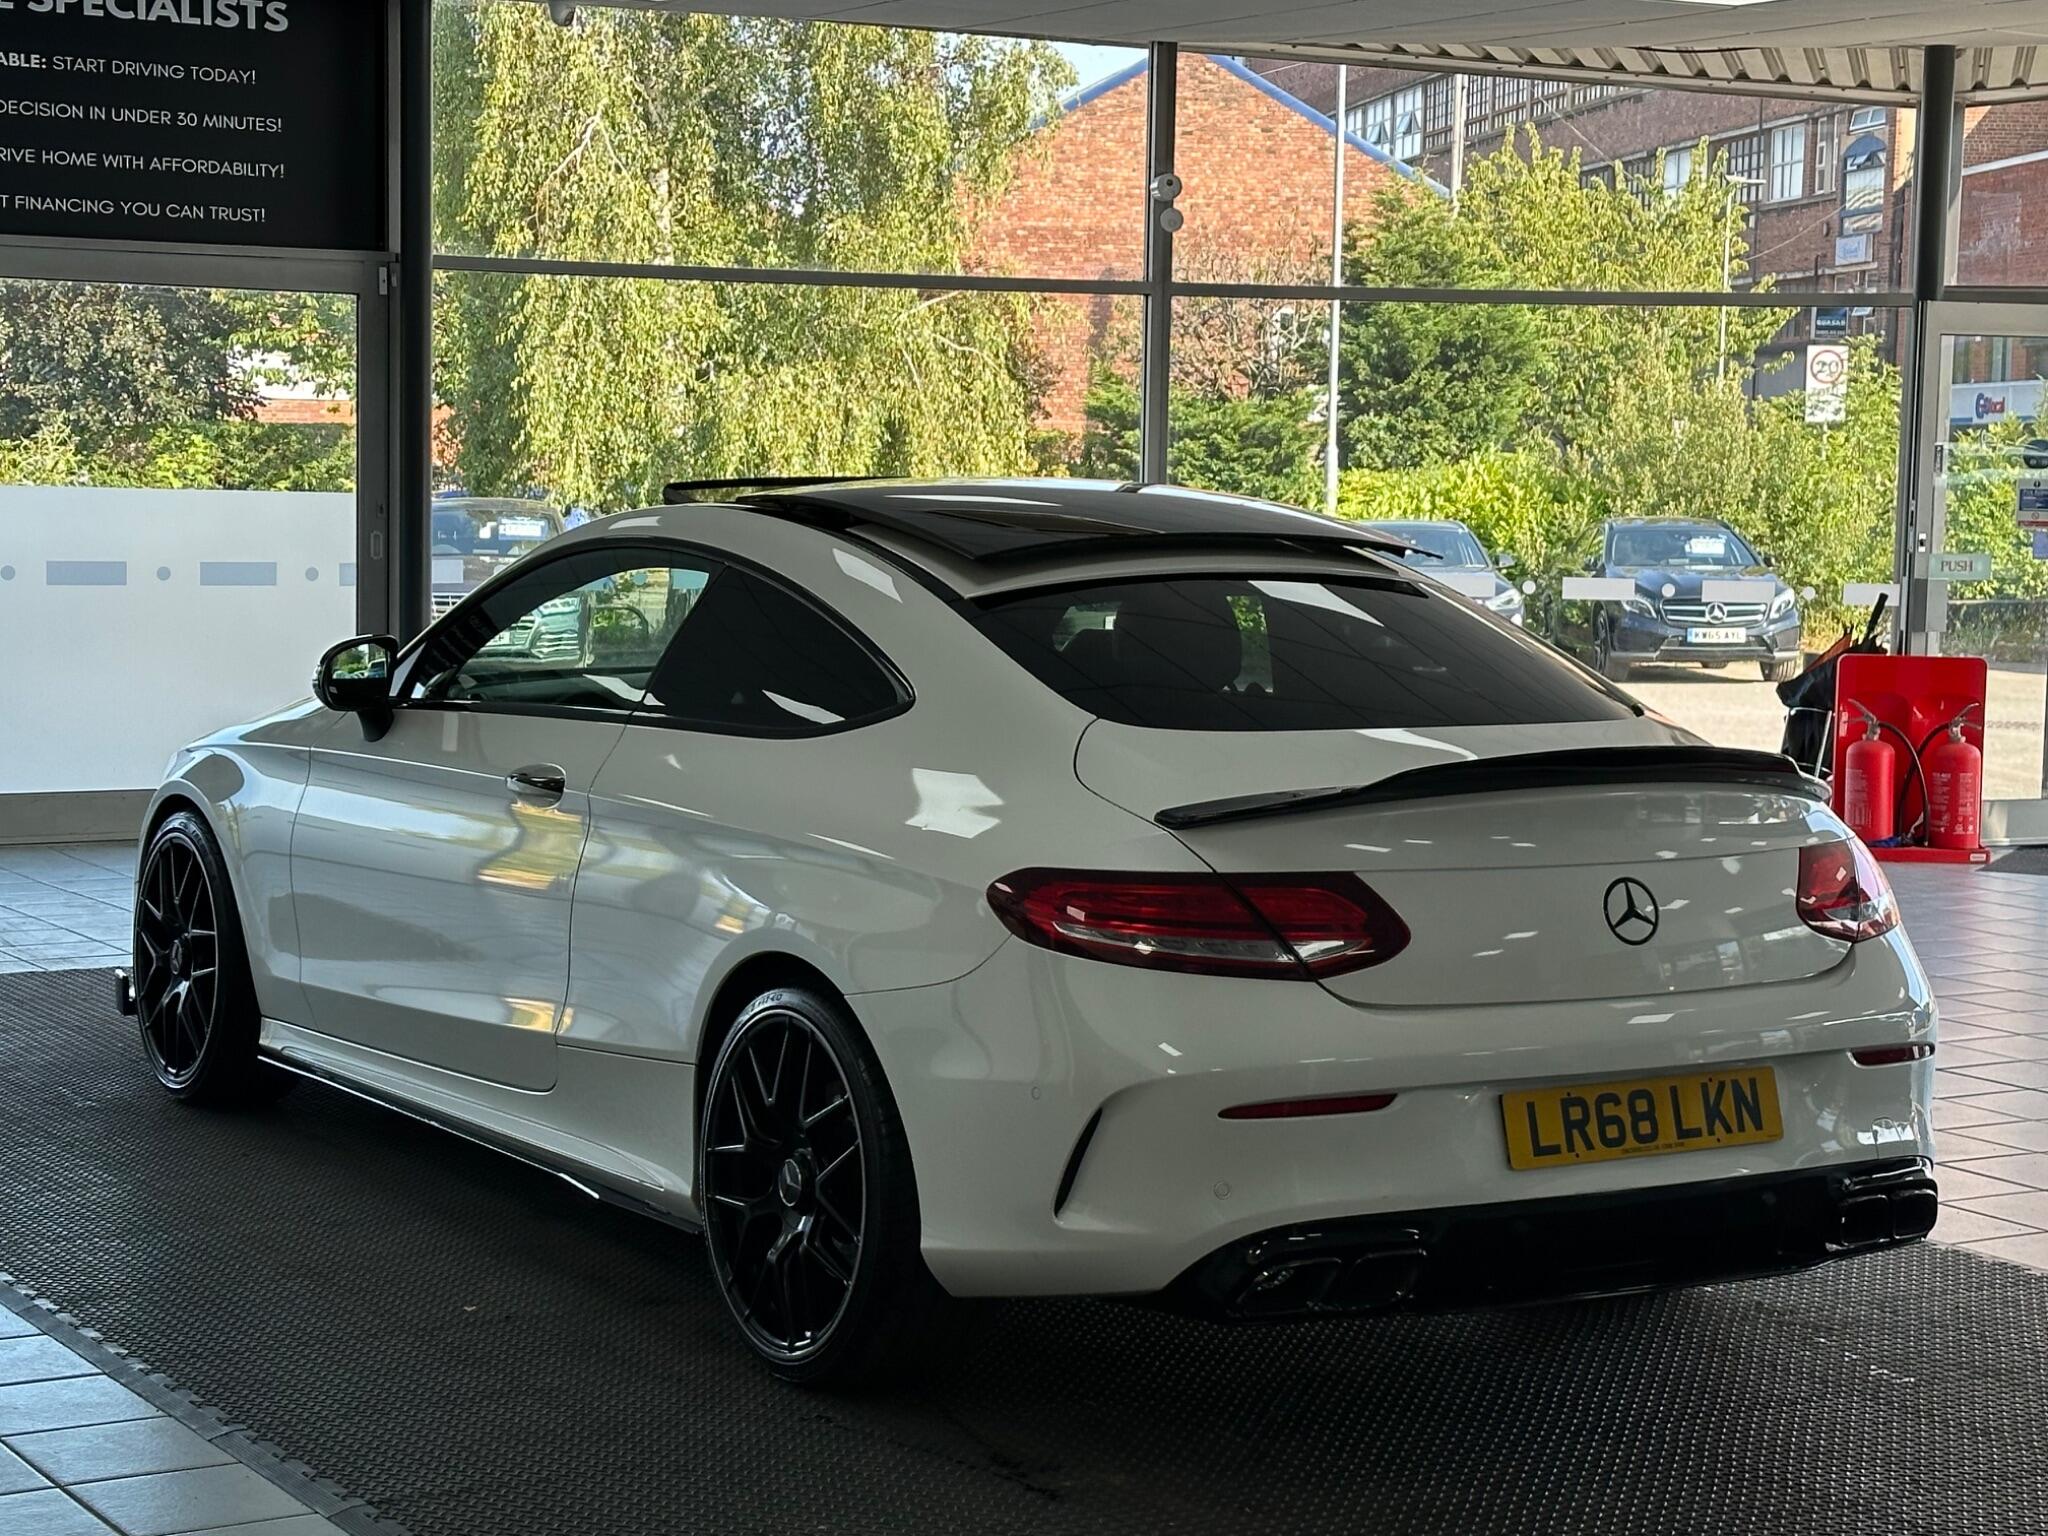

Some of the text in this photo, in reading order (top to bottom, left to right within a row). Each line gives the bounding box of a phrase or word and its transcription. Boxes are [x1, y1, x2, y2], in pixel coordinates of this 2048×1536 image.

[53, 56, 107, 73] START
[112, 60, 185, 79] DRIVING
[190, 66, 256, 84] TODAY!
[0, 99, 282, 133] DECISION IN UNDER 30 MINUTES!
[42, 150, 97, 167] HOME
[103, 154, 144, 170] WITH
[149, 157, 284, 178] AFFORDABILITY!
[15, 196, 115, 214] FINANCING
[120, 201, 161, 217] YOU
[166, 204, 204, 220] CAN
[209, 206, 265, 223] TRUST!
[1816, 360, 1839, 374] 20
[1941, 560, 1974, 572] PUSH
[1526, 1077, 1764, 1158] LR68 LKN
